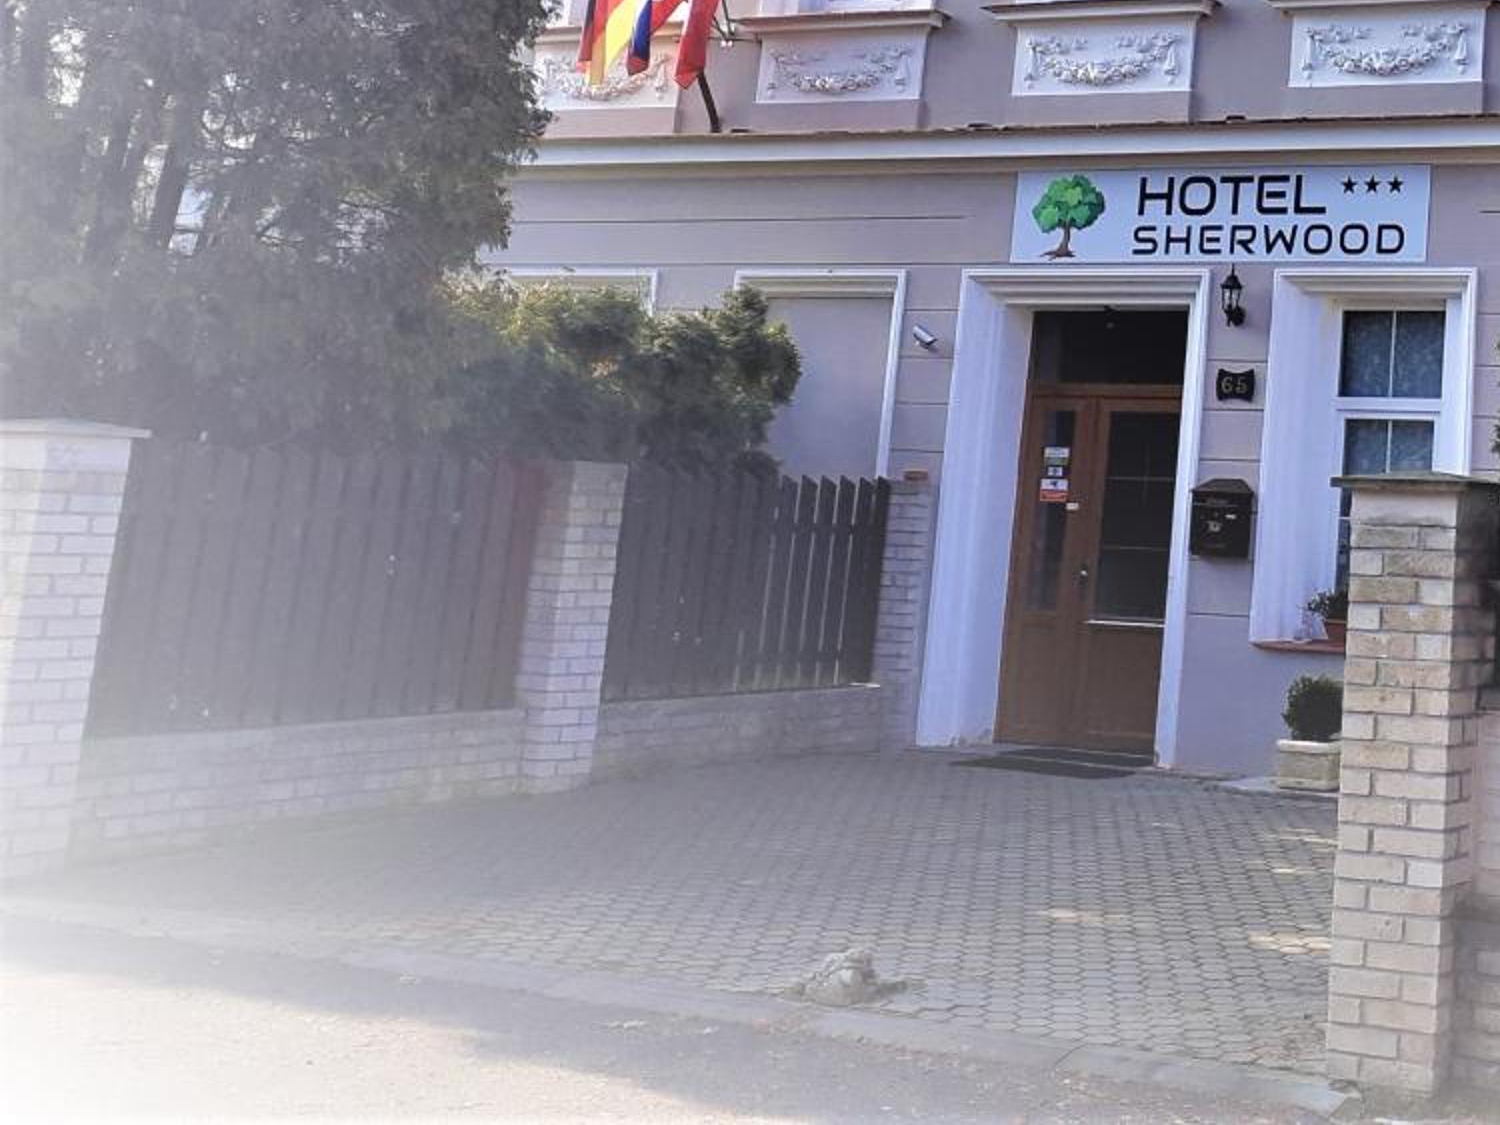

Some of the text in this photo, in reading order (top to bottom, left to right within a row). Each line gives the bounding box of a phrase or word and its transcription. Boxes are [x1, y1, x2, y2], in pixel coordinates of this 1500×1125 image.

[1137, 174, 1327, 216] HOTEL
[1132, 224, 1405, 255] SHERWOOD
[1221, 376, 1248, 394] 65
